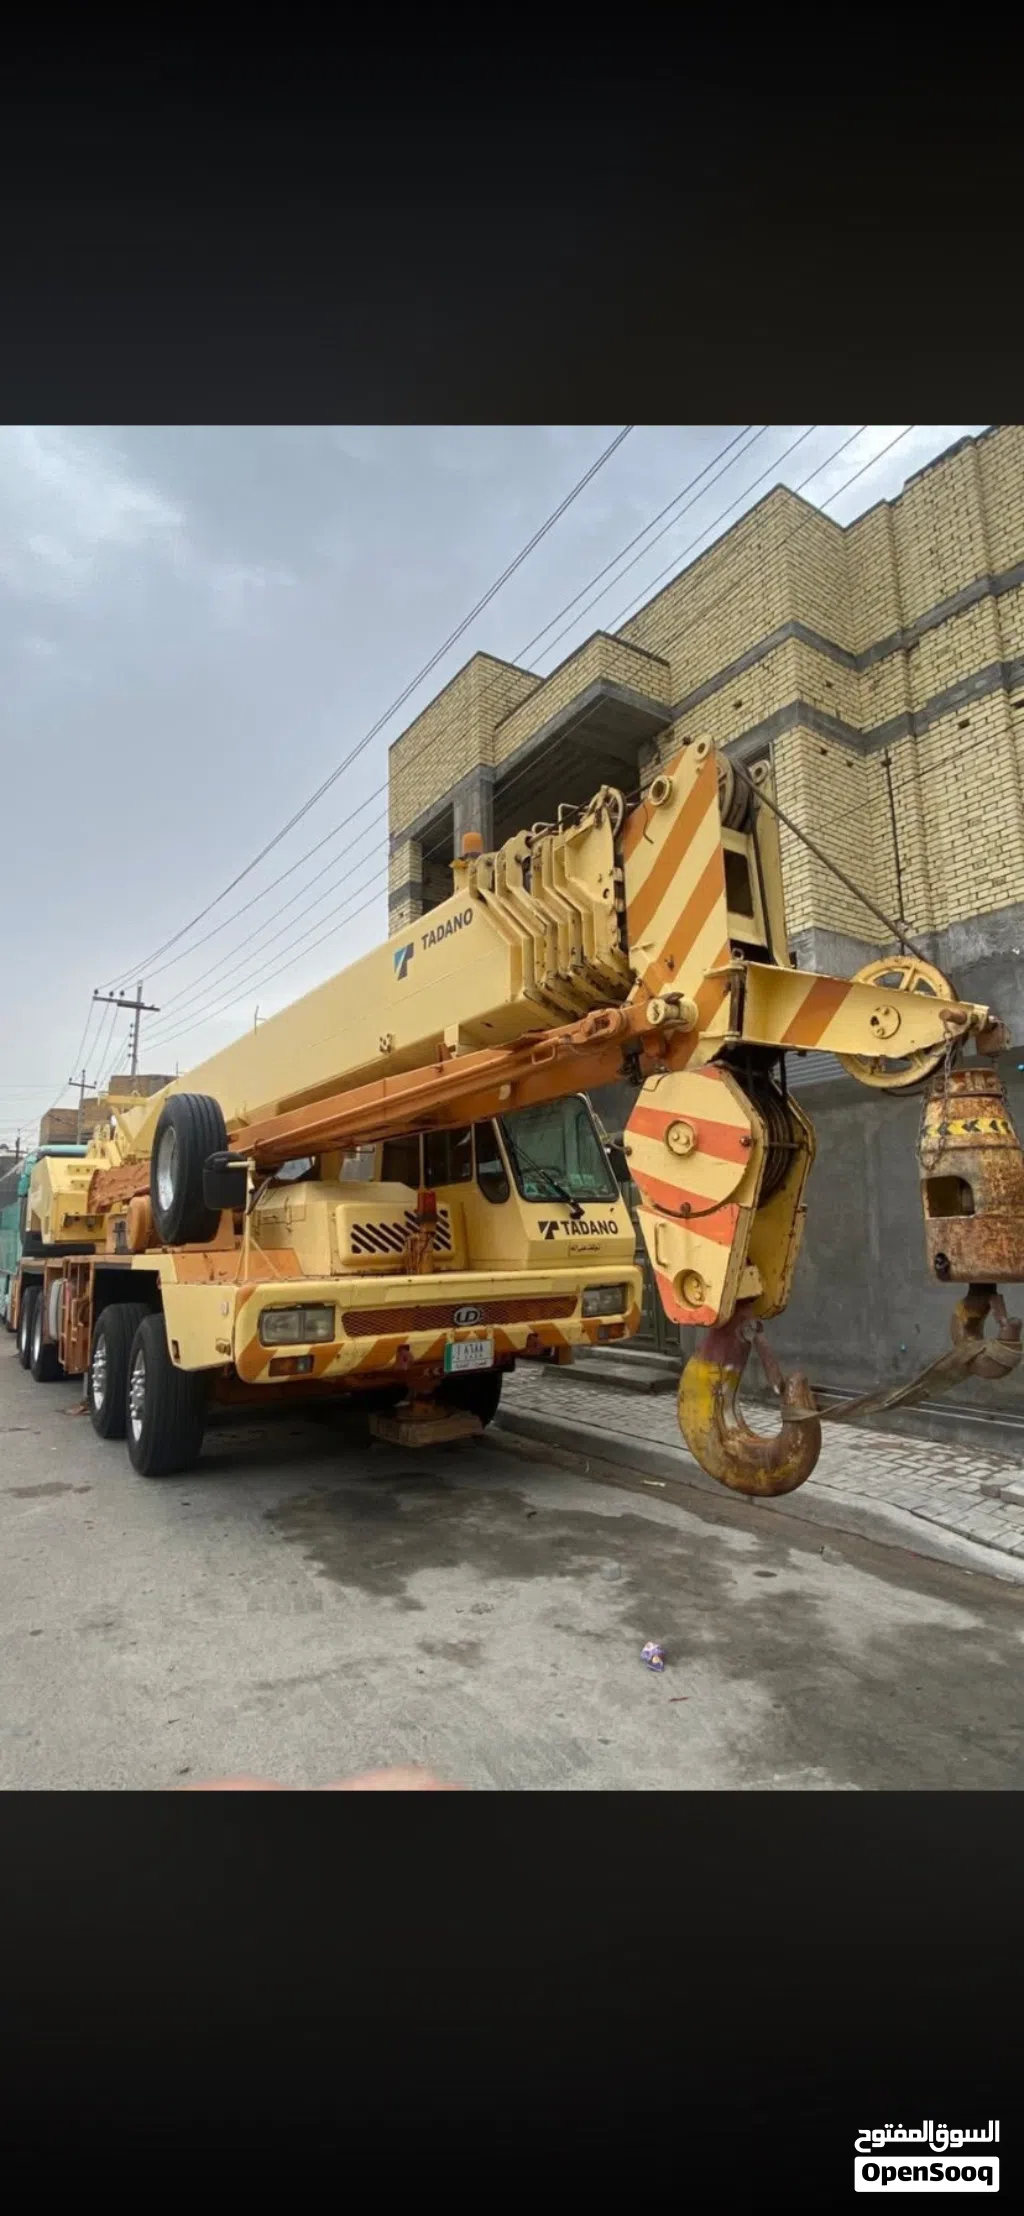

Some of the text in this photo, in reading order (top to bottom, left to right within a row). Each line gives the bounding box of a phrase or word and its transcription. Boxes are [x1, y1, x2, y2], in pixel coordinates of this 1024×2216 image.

[421, 907, 473, 951] TADANO
[560, 1220, 618, 1235] TADANO
[456, 1310, 478, 1323] UD
